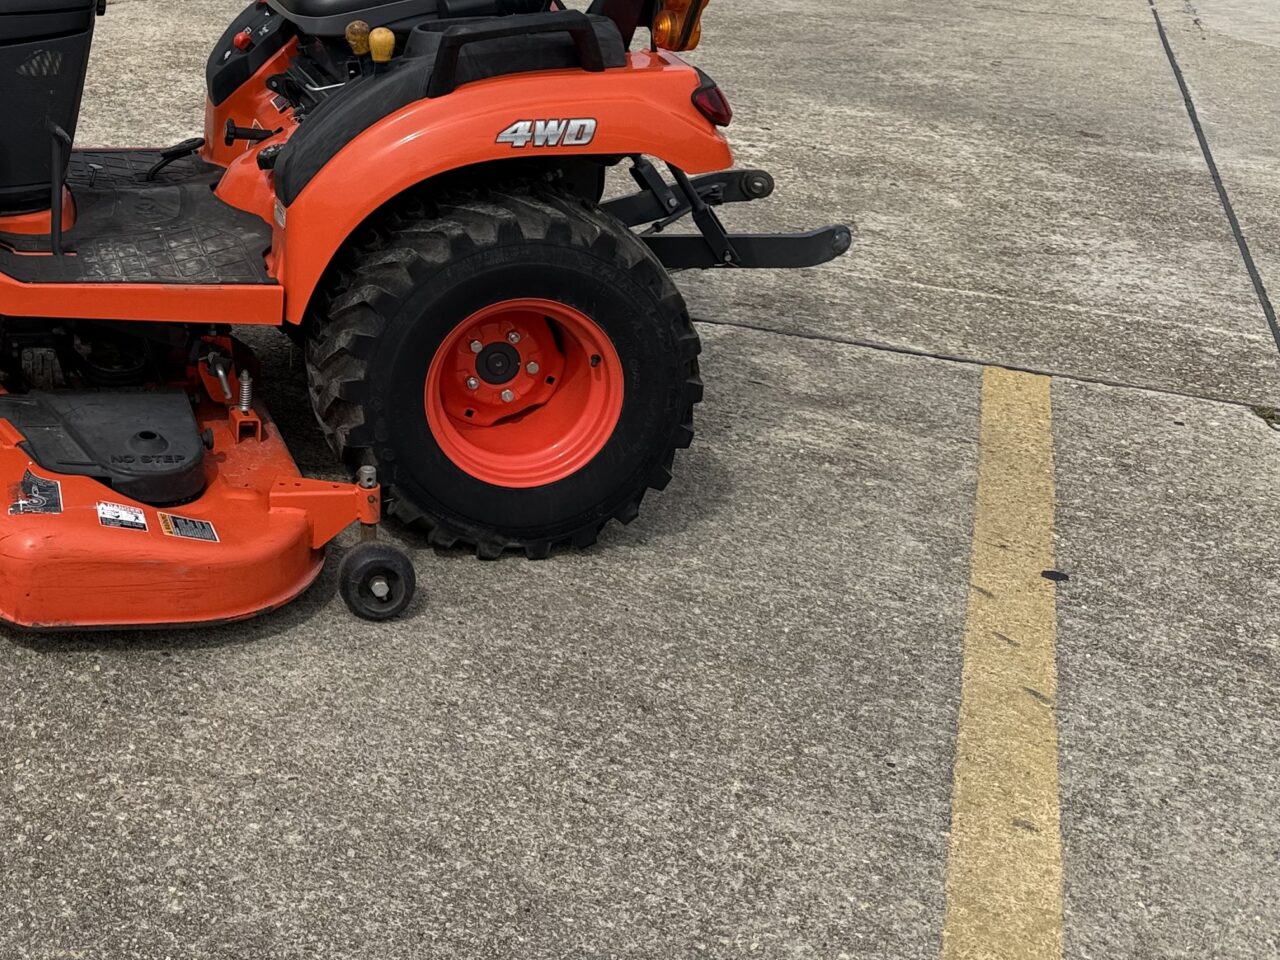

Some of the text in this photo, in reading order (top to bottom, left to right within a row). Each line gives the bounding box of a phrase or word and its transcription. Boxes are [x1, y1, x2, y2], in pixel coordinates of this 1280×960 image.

[495, 117, 598, 148] 4WD
[110, 454, 186, 464] NO STEP
